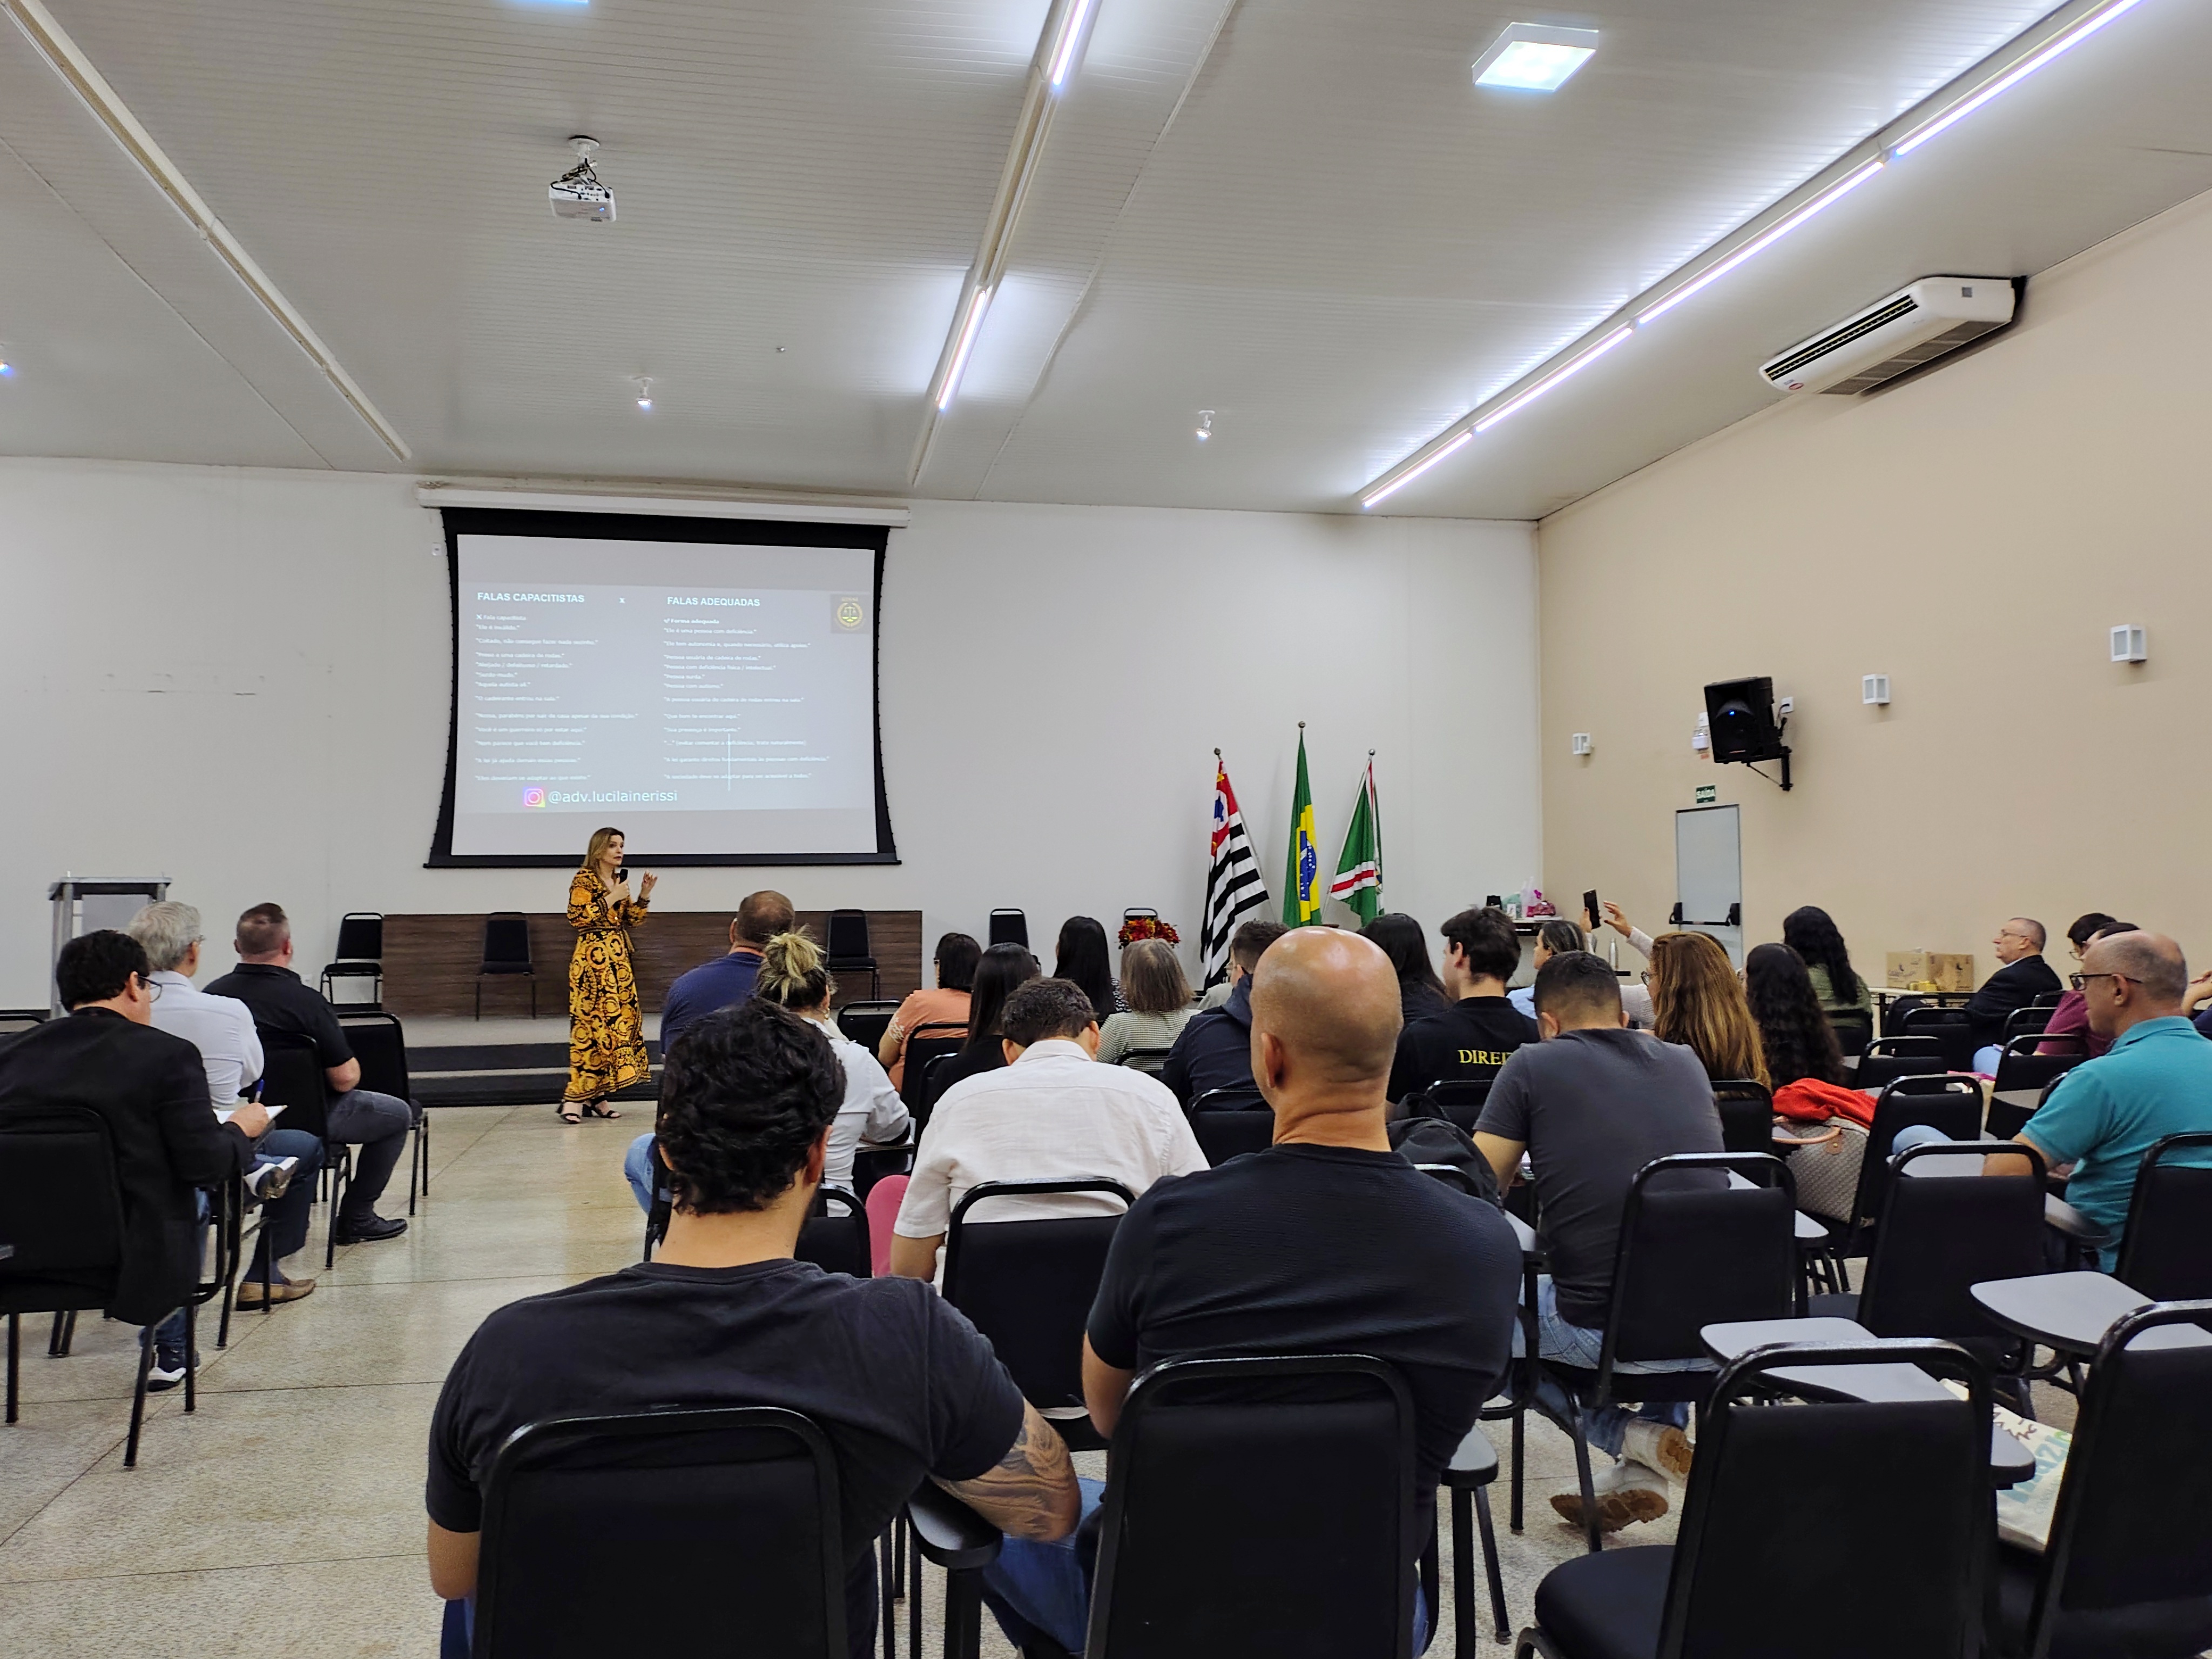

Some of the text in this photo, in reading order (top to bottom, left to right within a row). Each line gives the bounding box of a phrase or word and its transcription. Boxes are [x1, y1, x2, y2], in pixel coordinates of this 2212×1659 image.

[477, 592, 585, 603] FALAS CAPACITISTAS
[667, 596, 760, 606] FALAS ADEQUADAS
[548, 790, 678, 804] @adv.lucilainerissi
